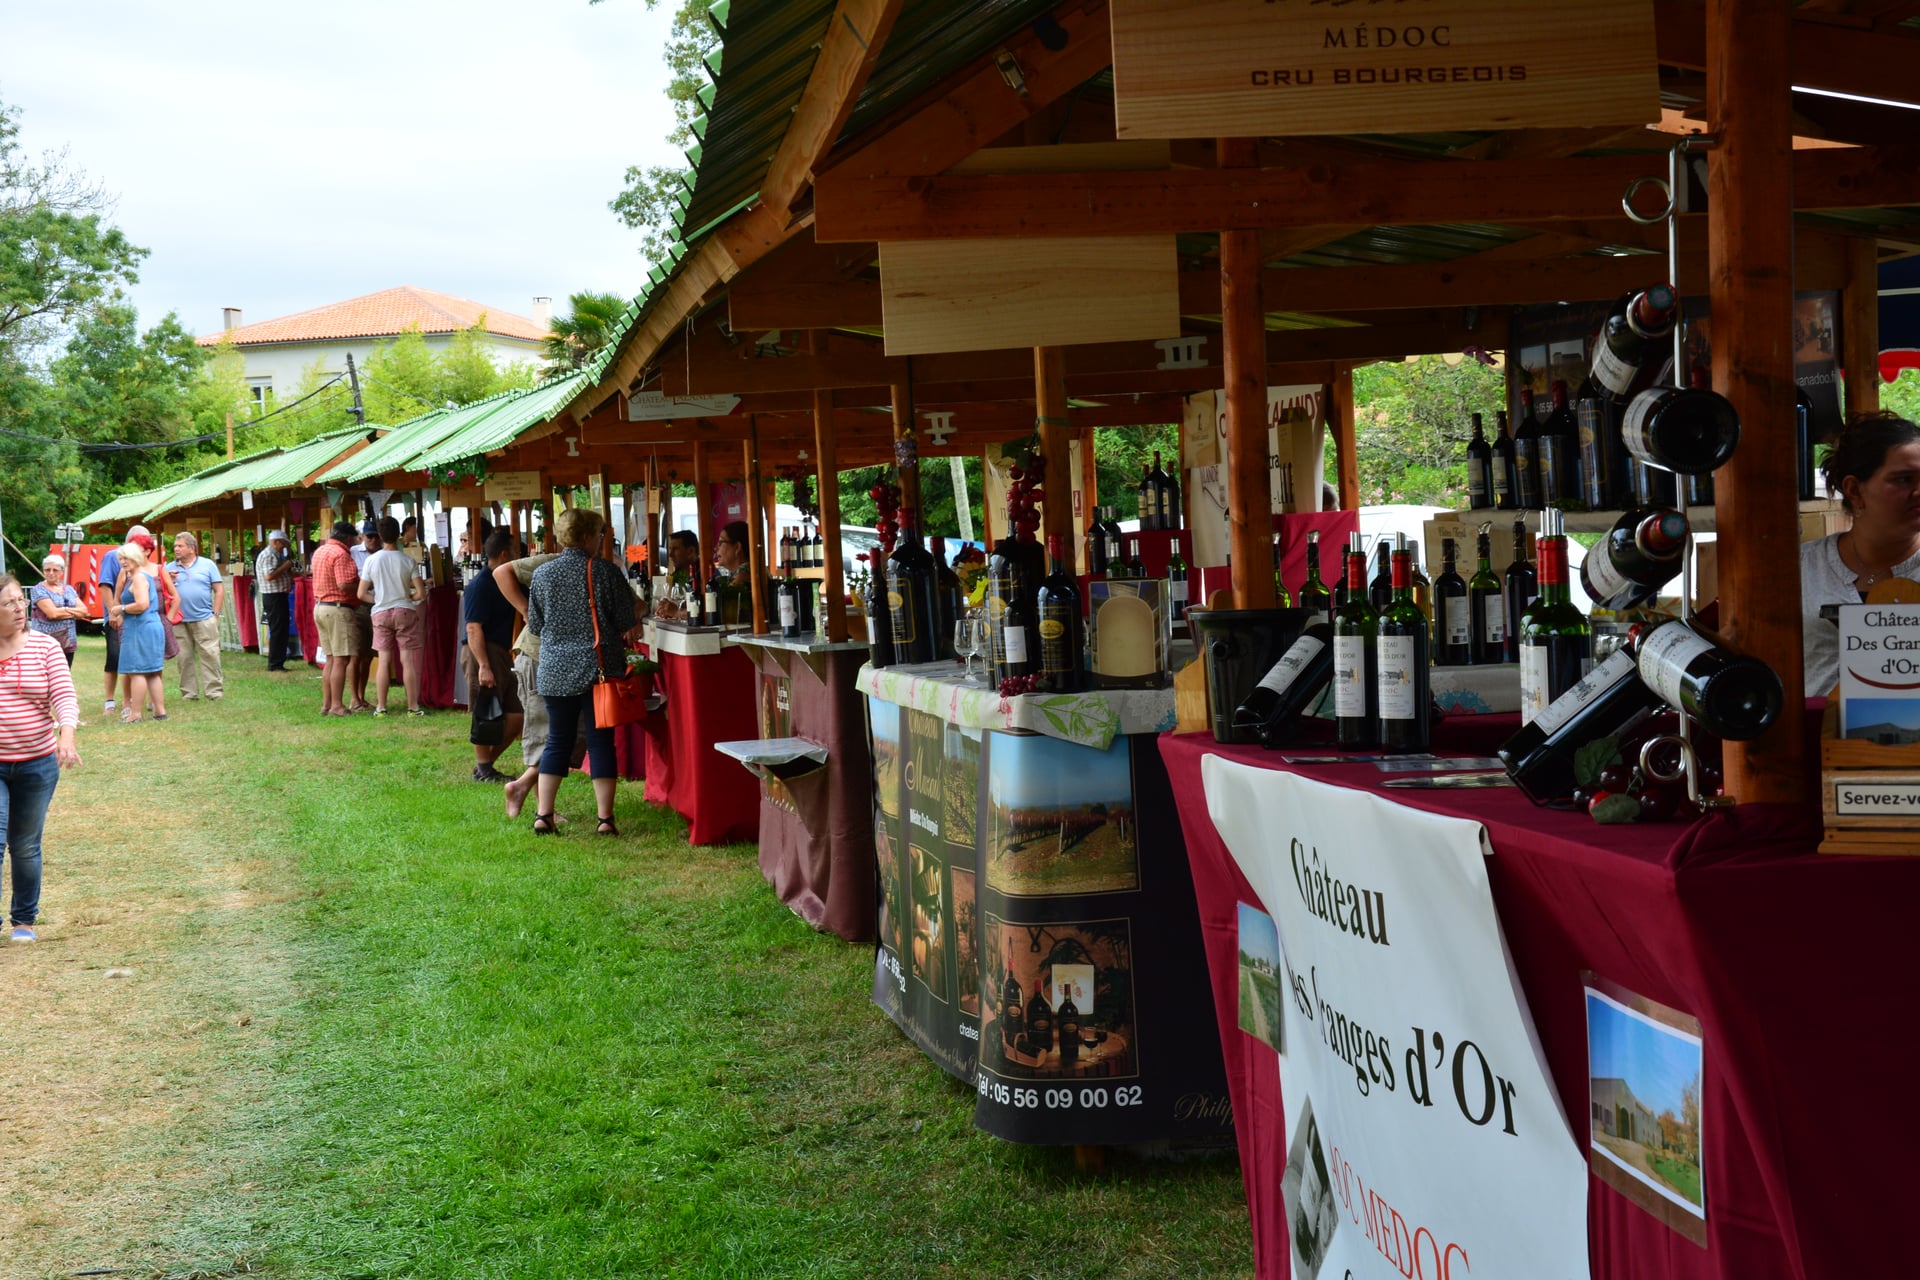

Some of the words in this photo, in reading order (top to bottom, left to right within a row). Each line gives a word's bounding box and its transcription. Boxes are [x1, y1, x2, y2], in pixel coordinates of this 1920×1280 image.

[1322, 22, 1452, 50] MÉDOC
[1251, 69, 1315, 87] CRU
[1333, 65, 1528, 85] BOURGEOIS
[1864, 610, 1920, 627] Châtea
[1846, 635, 1878, 651] Des
[1881, 658, 1920, 674] d'Or
[1843, 790, 1920, 806] Servez-v
[1290, 837, 1390, 946] Château
[1406, 1027, 1518, 1137] d'Or
[994, 1083, 1010, 1105] 05
[1014, 1088, 1039, 1109] 56
[1045, 1088, 1074, 1109] 09
[1080, 1088, 1109, 1109] 00
[1115, 1085, 1143, 1107] 62
[1173, 1090, 1235, 1128] Philip
